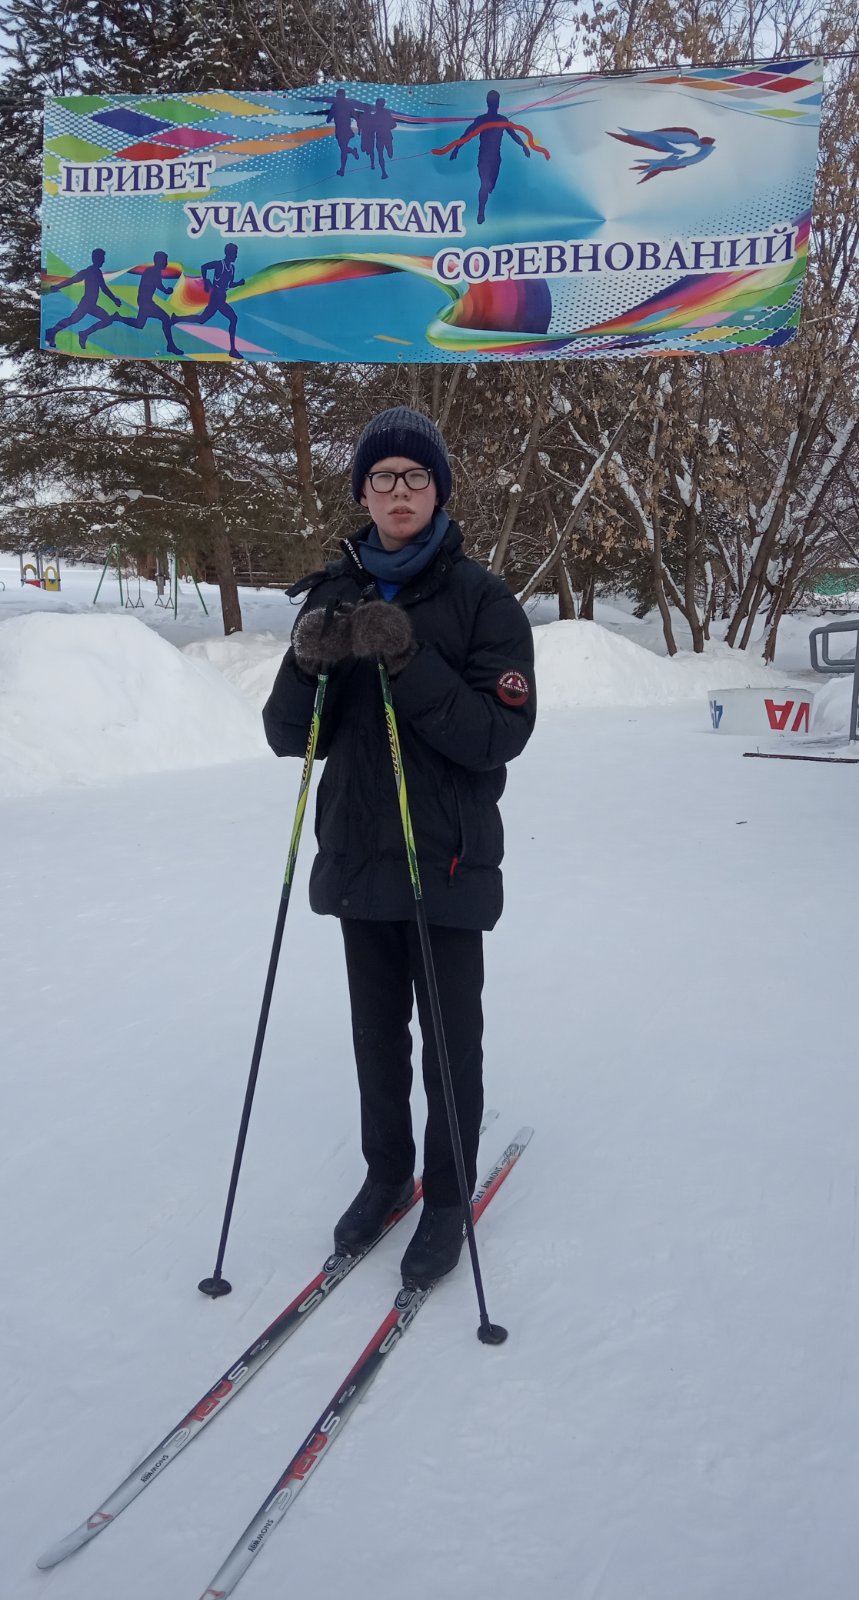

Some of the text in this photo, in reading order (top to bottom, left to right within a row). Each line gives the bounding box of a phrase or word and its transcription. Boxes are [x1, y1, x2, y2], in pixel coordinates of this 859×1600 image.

[62, 160, 212, 193] ПРИВЕТ
[188, 202, 462, 234] УЧАСТНИКАМ
[437, 227, 795, 281] СОРЕВНОВАНИЙ
